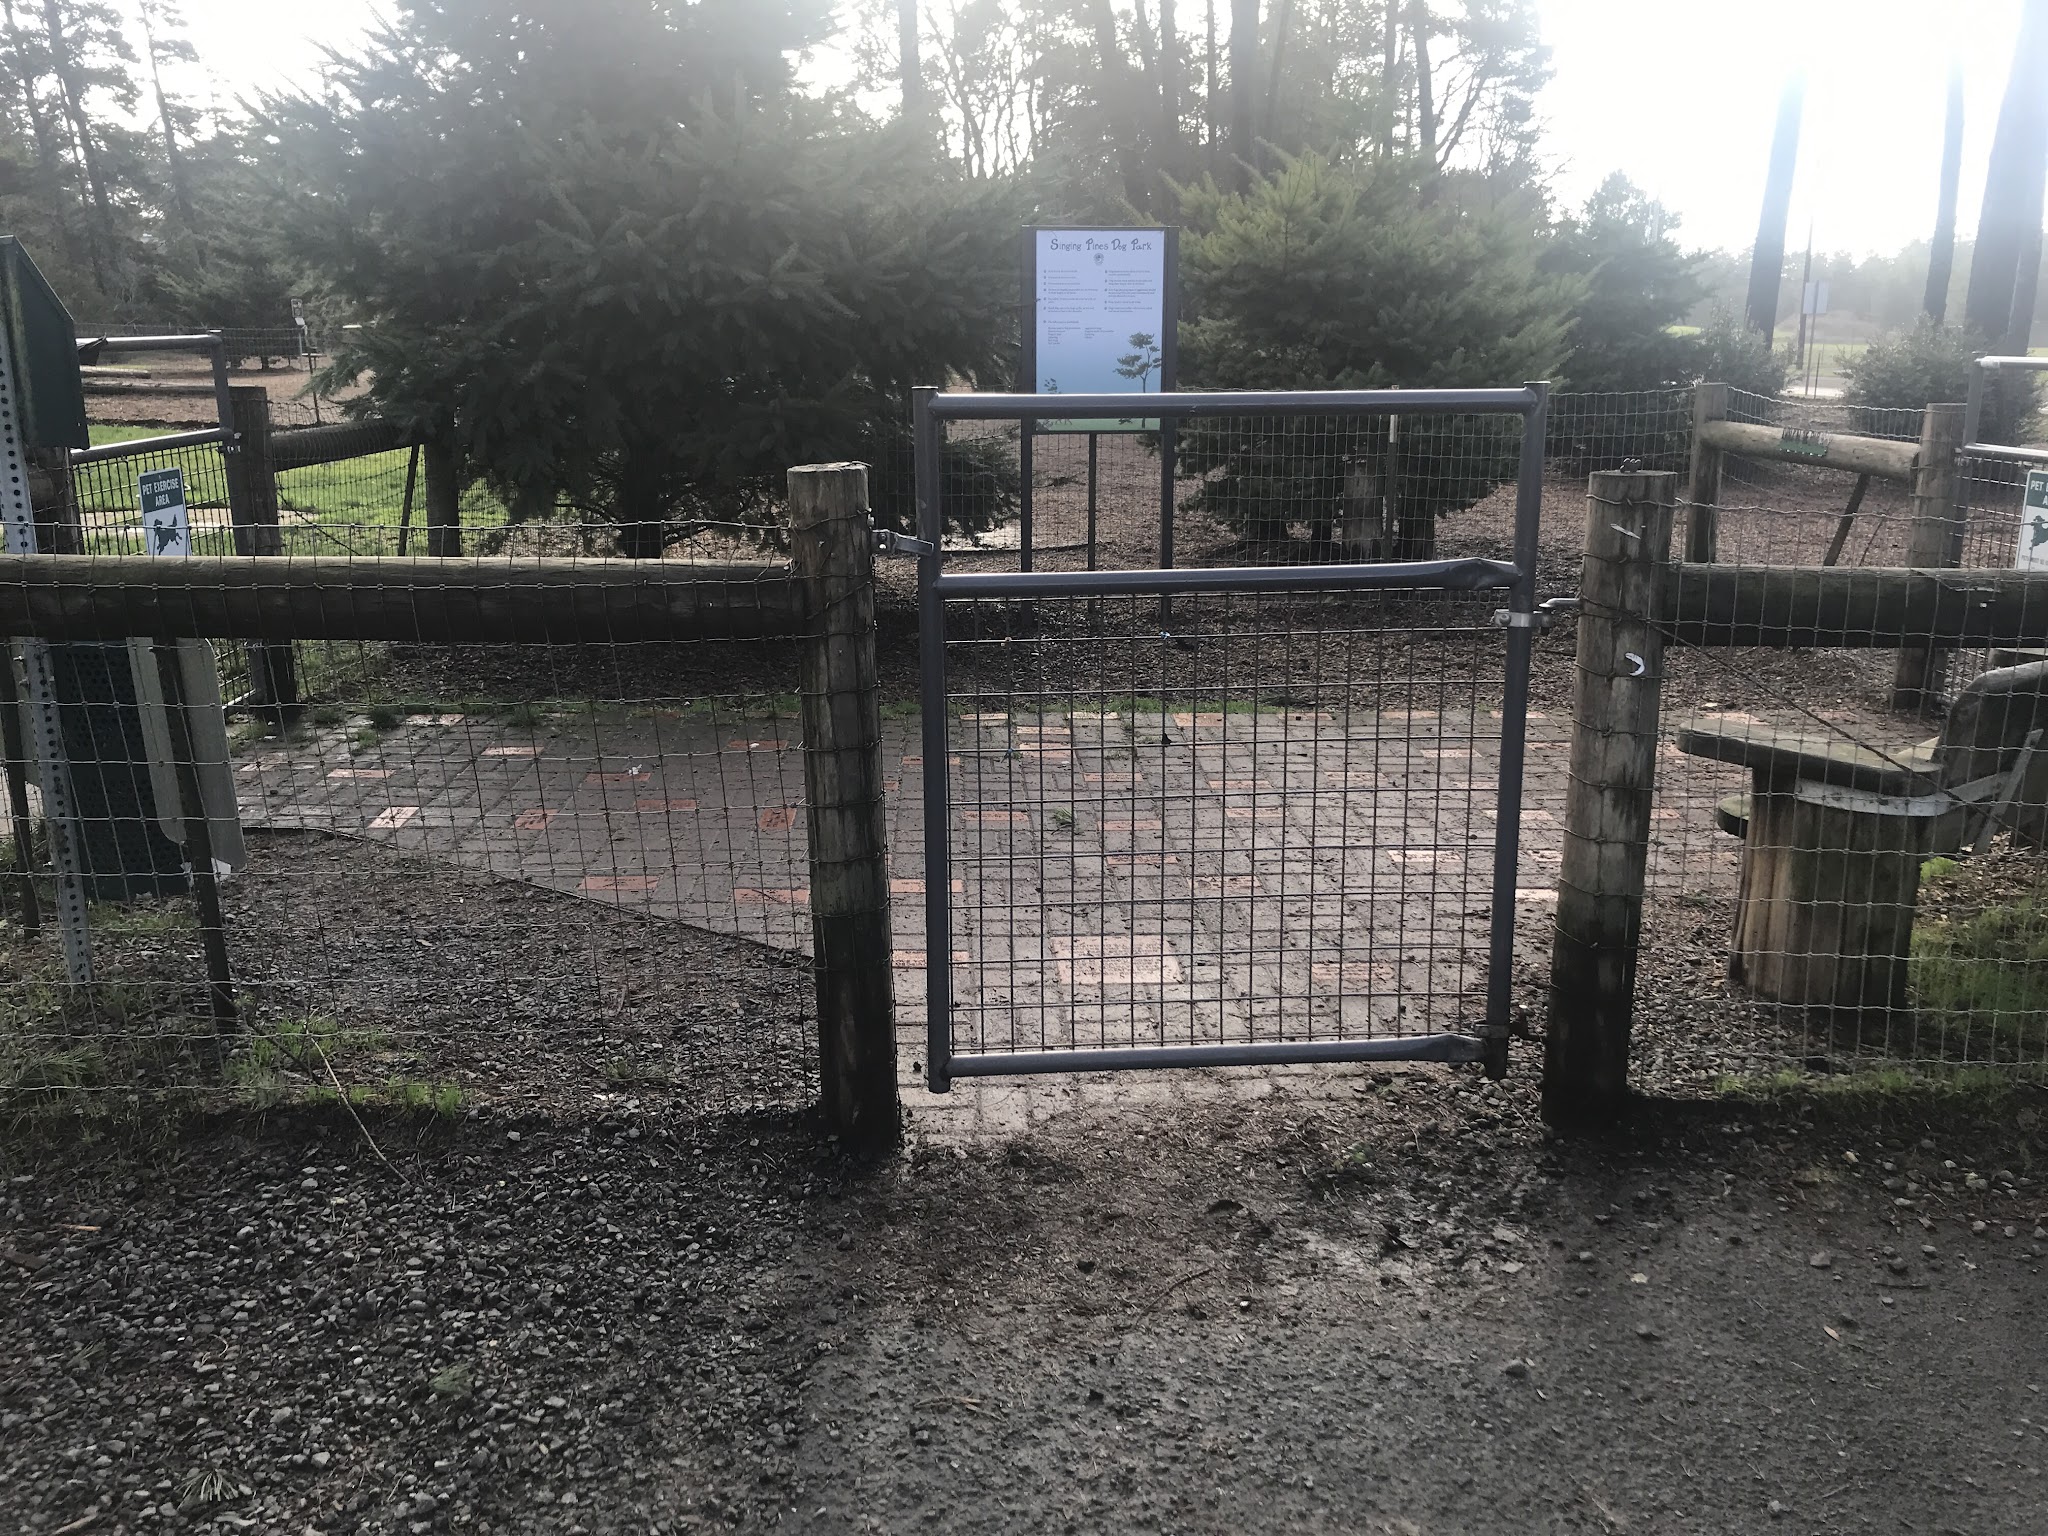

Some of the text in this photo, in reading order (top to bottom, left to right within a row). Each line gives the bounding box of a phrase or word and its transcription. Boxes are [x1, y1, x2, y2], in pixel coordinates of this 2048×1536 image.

[1050, 237, 1152, 251] Singing Pines Dog Park
[142, 478, 179, 495] PET EXERCISE
[2030, 480, 2044, 491] PET
[155, 493, 170, 507] AREA
